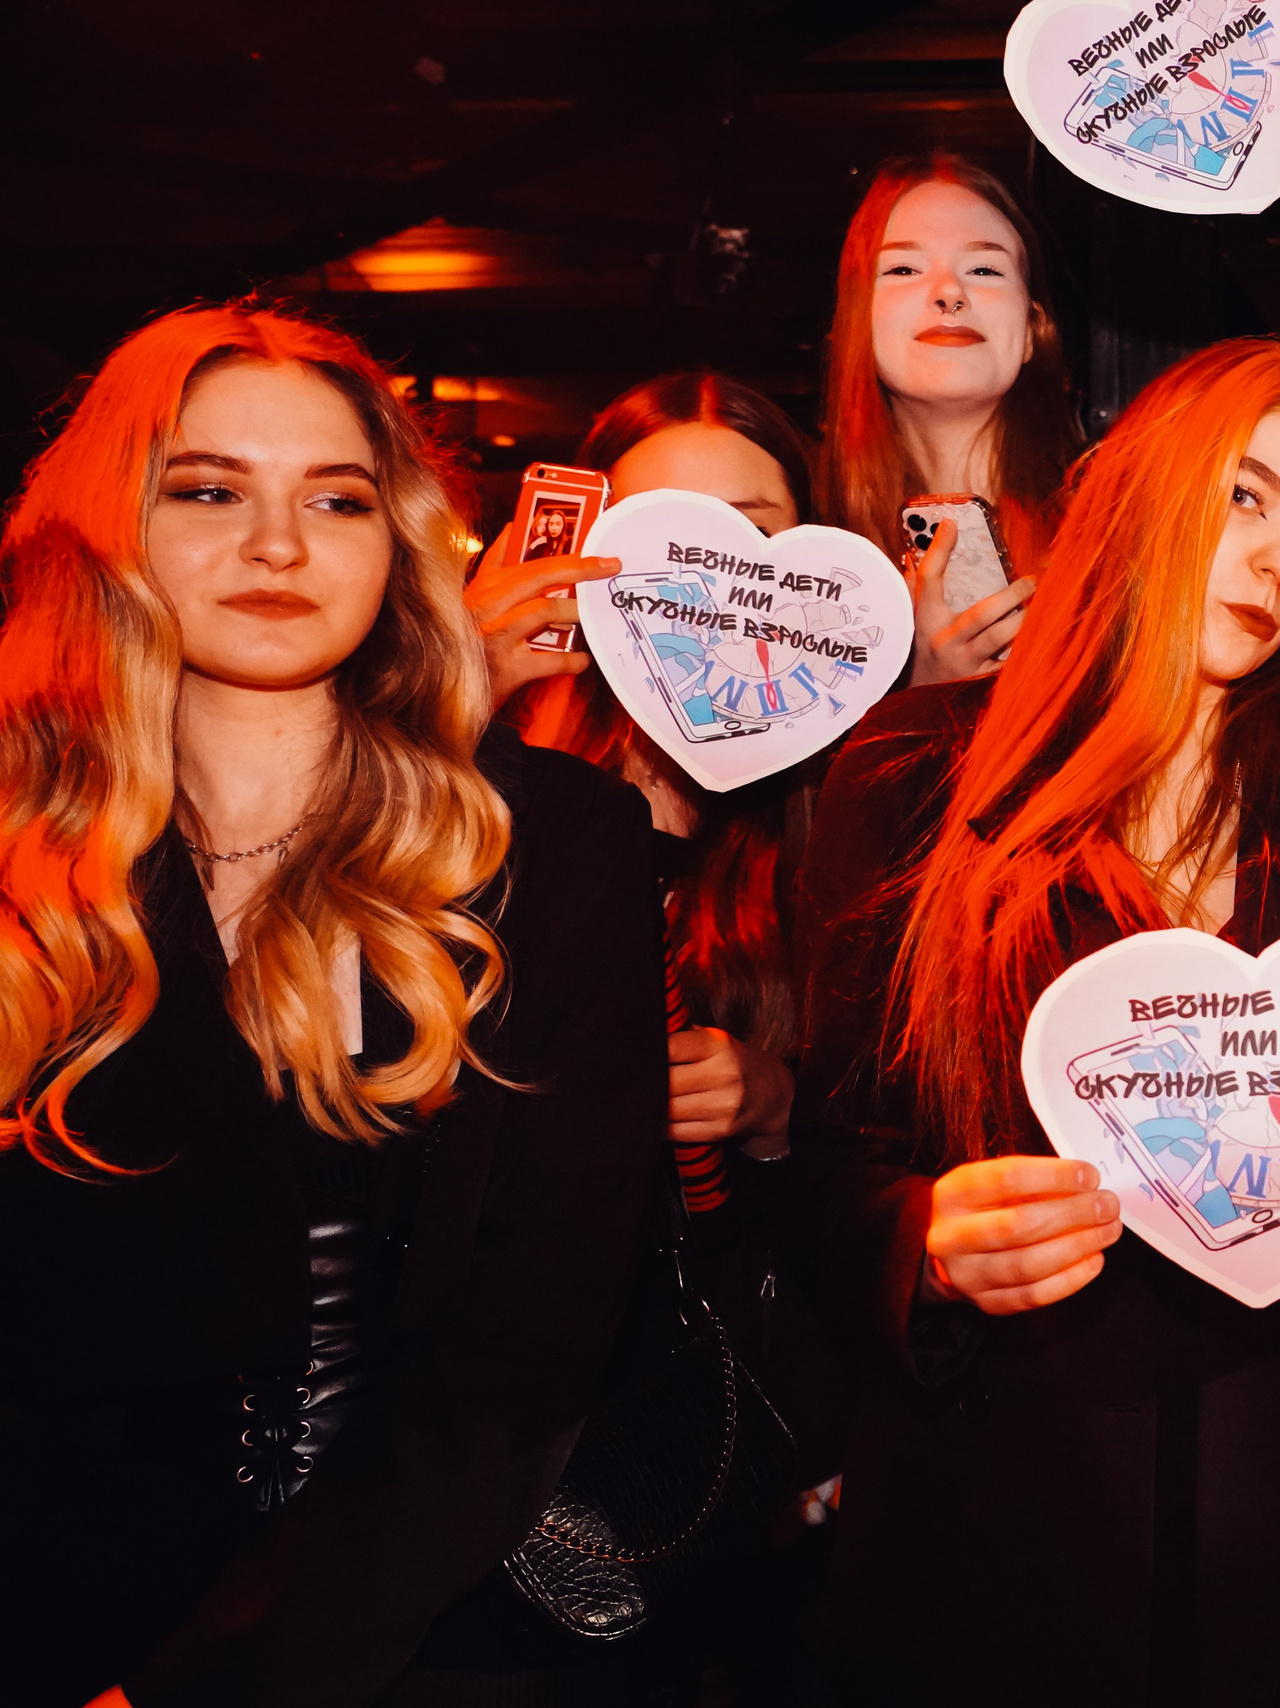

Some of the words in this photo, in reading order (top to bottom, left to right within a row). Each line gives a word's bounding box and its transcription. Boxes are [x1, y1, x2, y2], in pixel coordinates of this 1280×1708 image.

[1068, 11, 1153, 77] ВЕЧНЫЕ
[1135, 33, 1175, 68] ИЛИ
[1076, 72, 1168, 144] СКУЧНЫЕ
[1165, 4, 1267, 82] ВЗРОСЛЫЕ
[667, 542, 775, 581] ВЕЧНЫЕ
[779, 572, 842, 602] ДЕТИ
[728, 586, 773, 612] ИЛИ
[611, 591, 737, 631] СКУЧНЫЕ
[742, 618, 868, 663] ВЗРОСЛЫЕ
[1128, 990, 1275, 1022] ВЕЧНЫЕ
[1221, 1030, 1277, 1057] ИЛИ
[1074, 1070, 1239, 1101] СКУЧНЫЕ
